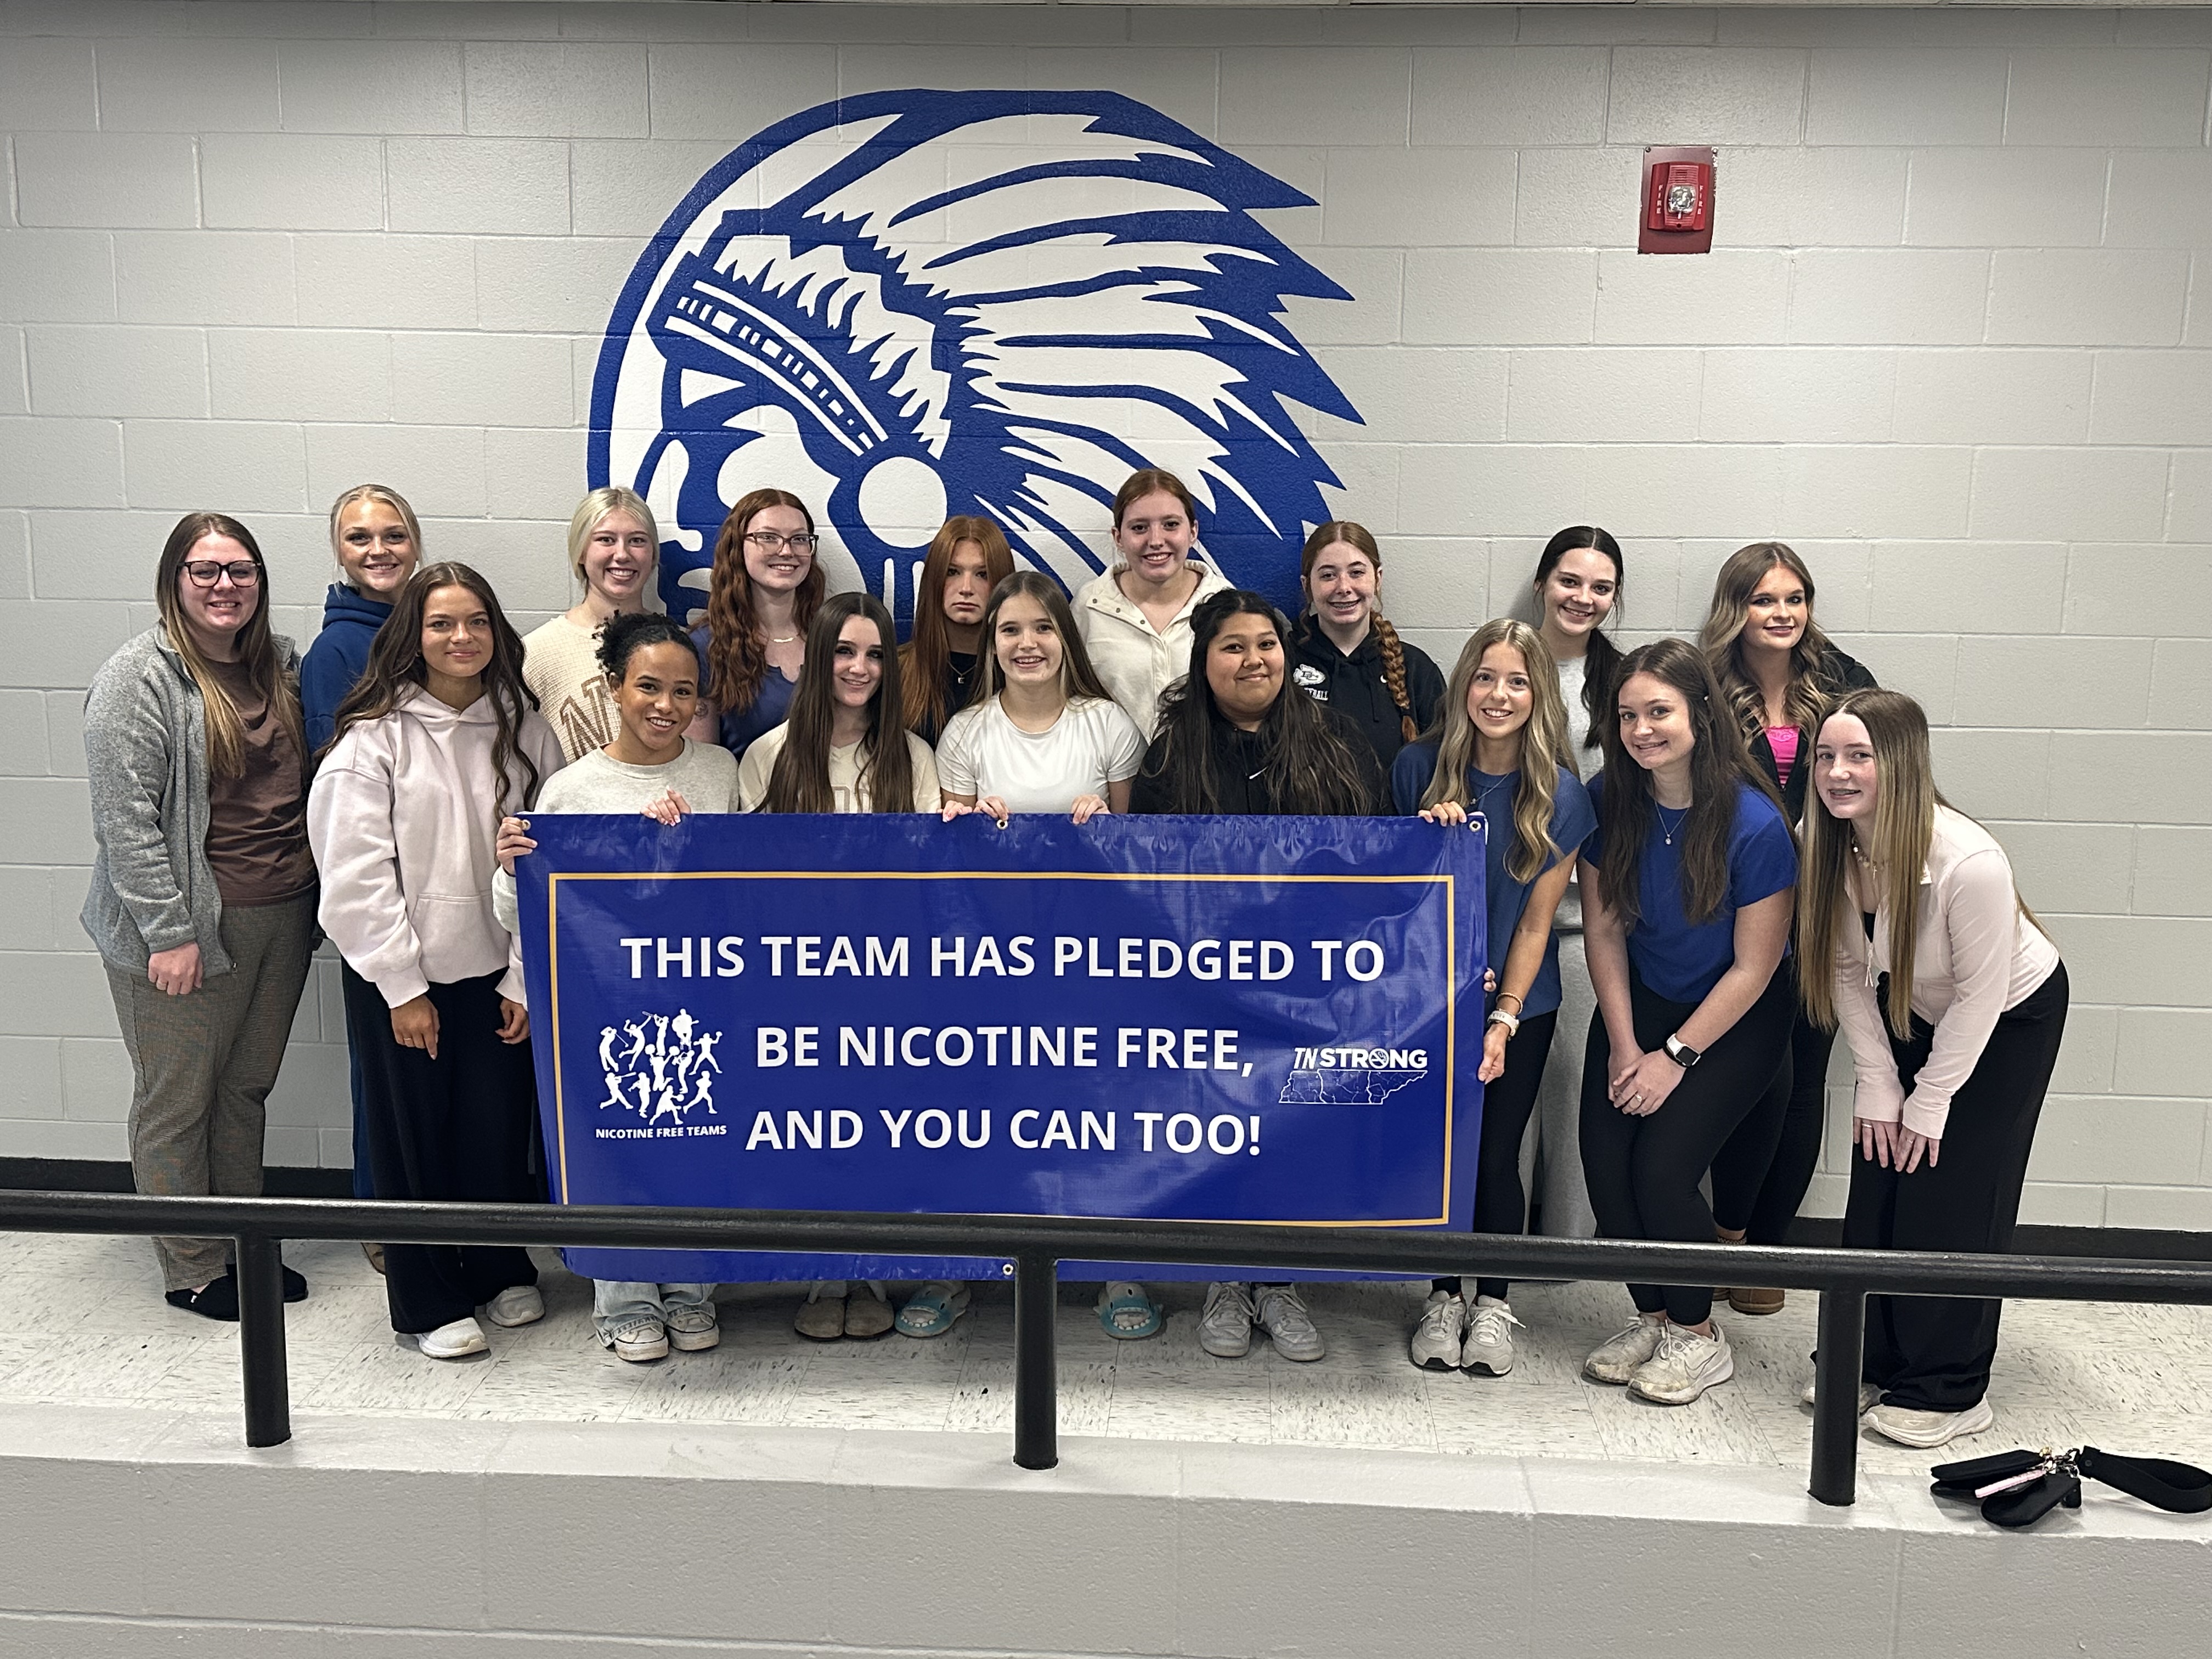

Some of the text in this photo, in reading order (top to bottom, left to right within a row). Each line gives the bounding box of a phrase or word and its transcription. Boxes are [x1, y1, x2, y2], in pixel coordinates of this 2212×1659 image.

[620, 935, 1384, 983] THIS TEAM HAS PLEDGED TO
[757, 1025, 1254, 1077] BE NICOTINE FREE,
[596, 1125, 727, 1139] NICOTINE FREE TEAMS
[745, 1108, 1260, 1156] AND YOU CAN TOO!
